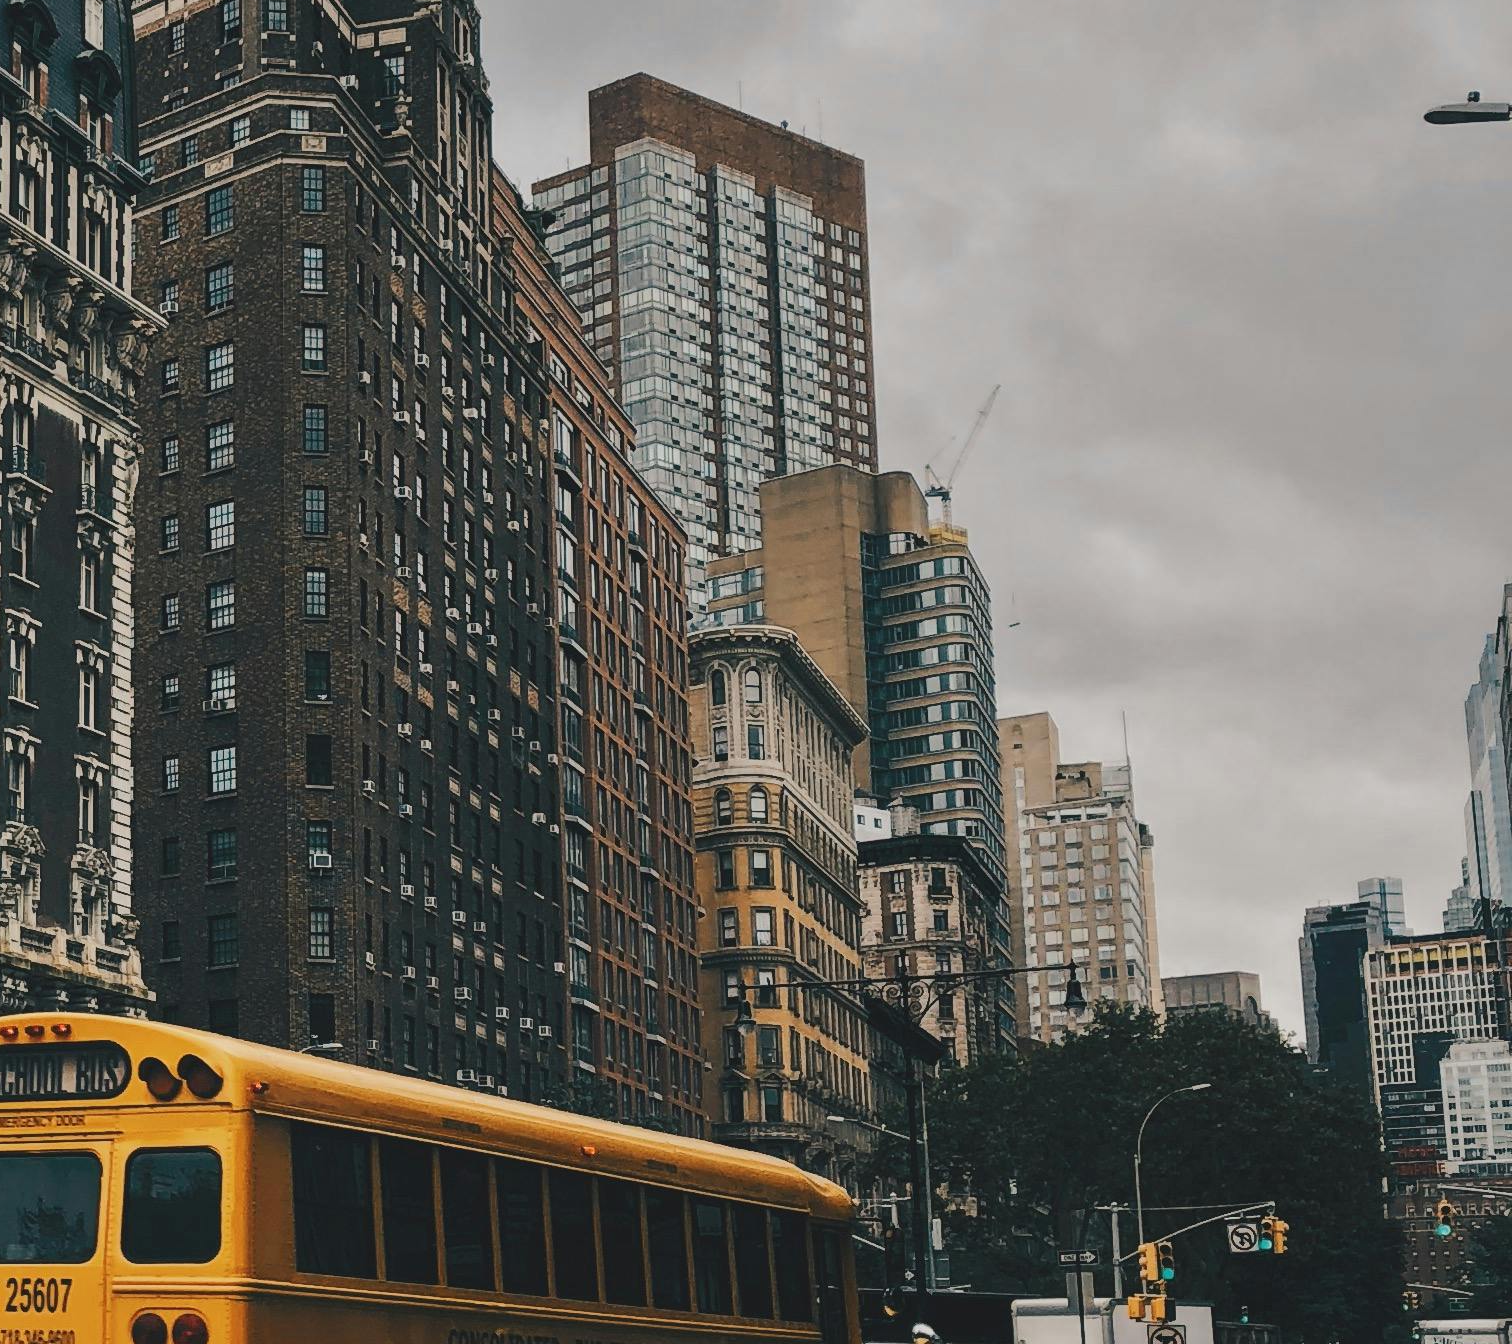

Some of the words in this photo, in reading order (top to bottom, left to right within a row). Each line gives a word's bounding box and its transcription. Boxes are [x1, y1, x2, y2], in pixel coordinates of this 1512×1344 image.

[75, 1052, 120, 1094] BUS
[56, 1115, 85, 1127] DOOR
[5, 1277, 73, 1313] 25607
